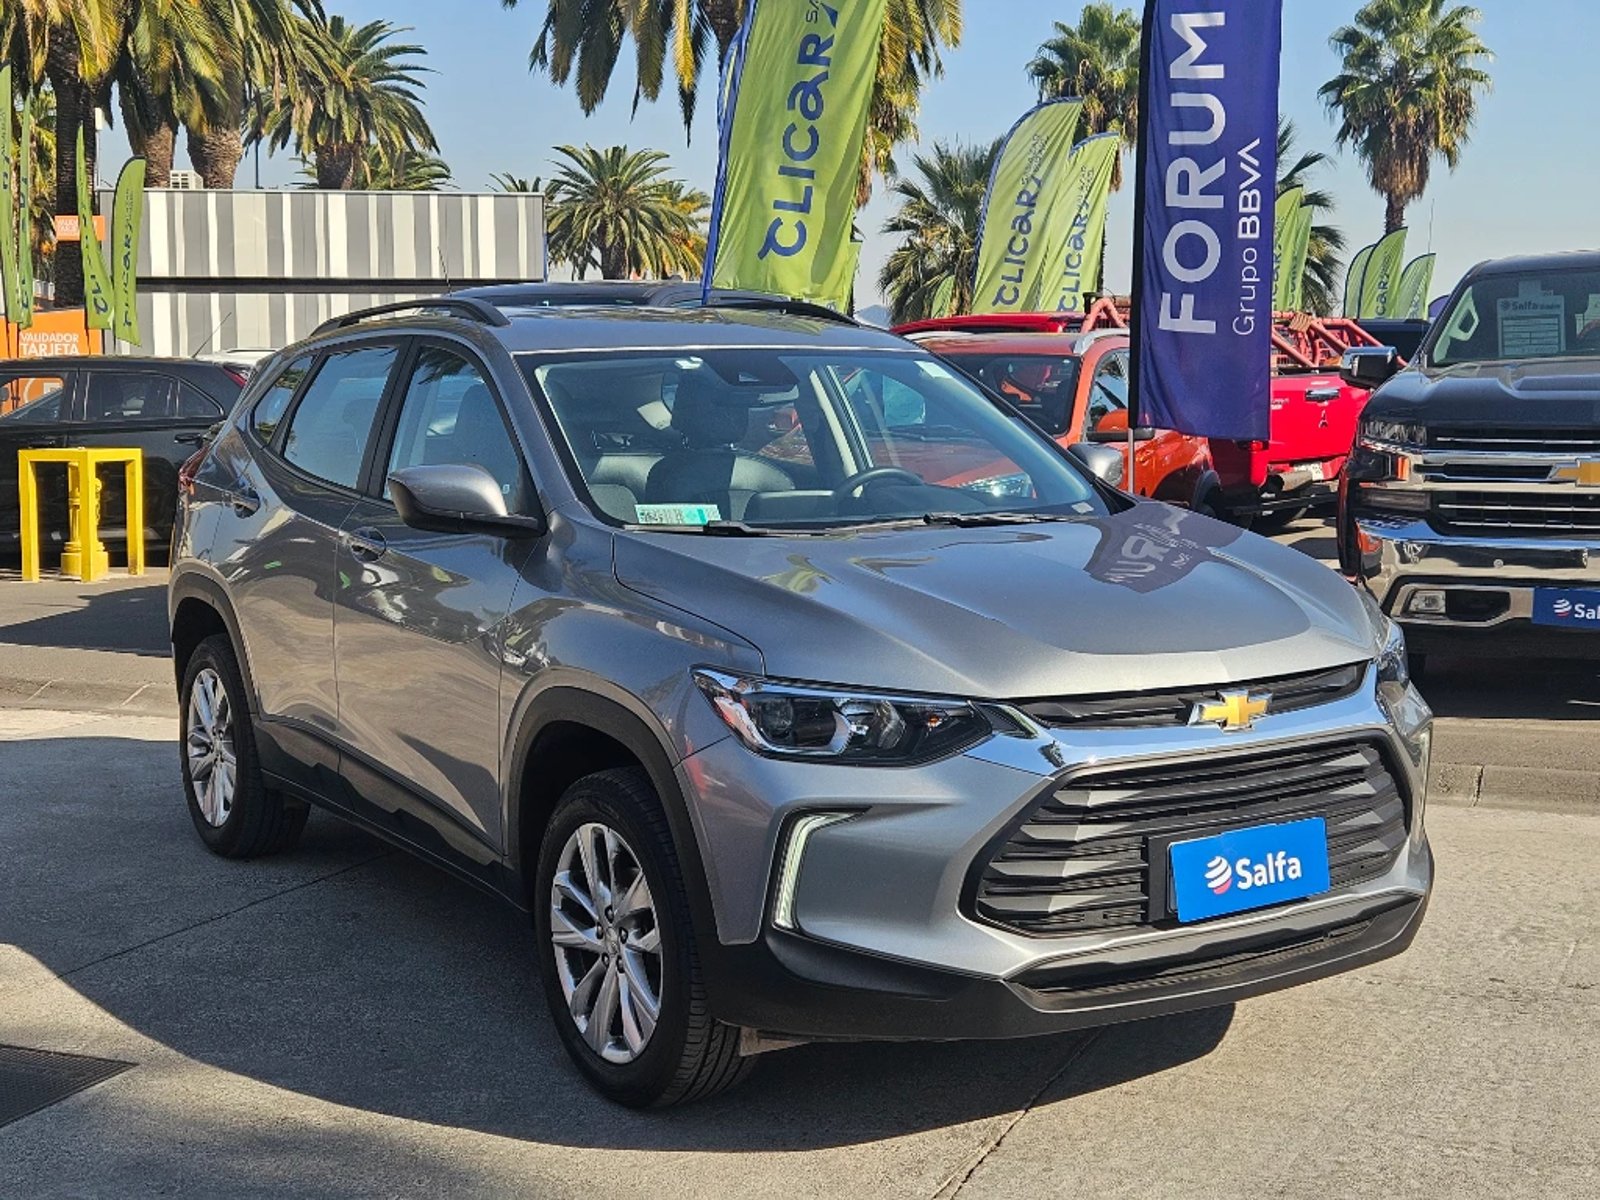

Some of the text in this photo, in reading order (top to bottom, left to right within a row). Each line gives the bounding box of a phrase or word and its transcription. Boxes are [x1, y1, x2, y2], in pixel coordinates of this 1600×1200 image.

[1158, 12, 1226, 334] FORUM
[1232, 138, 1262, 335] Grupo BBVA
[20, 343, 80, 356] TARJETA
[1235, 850, 1303, 890] Salfa
